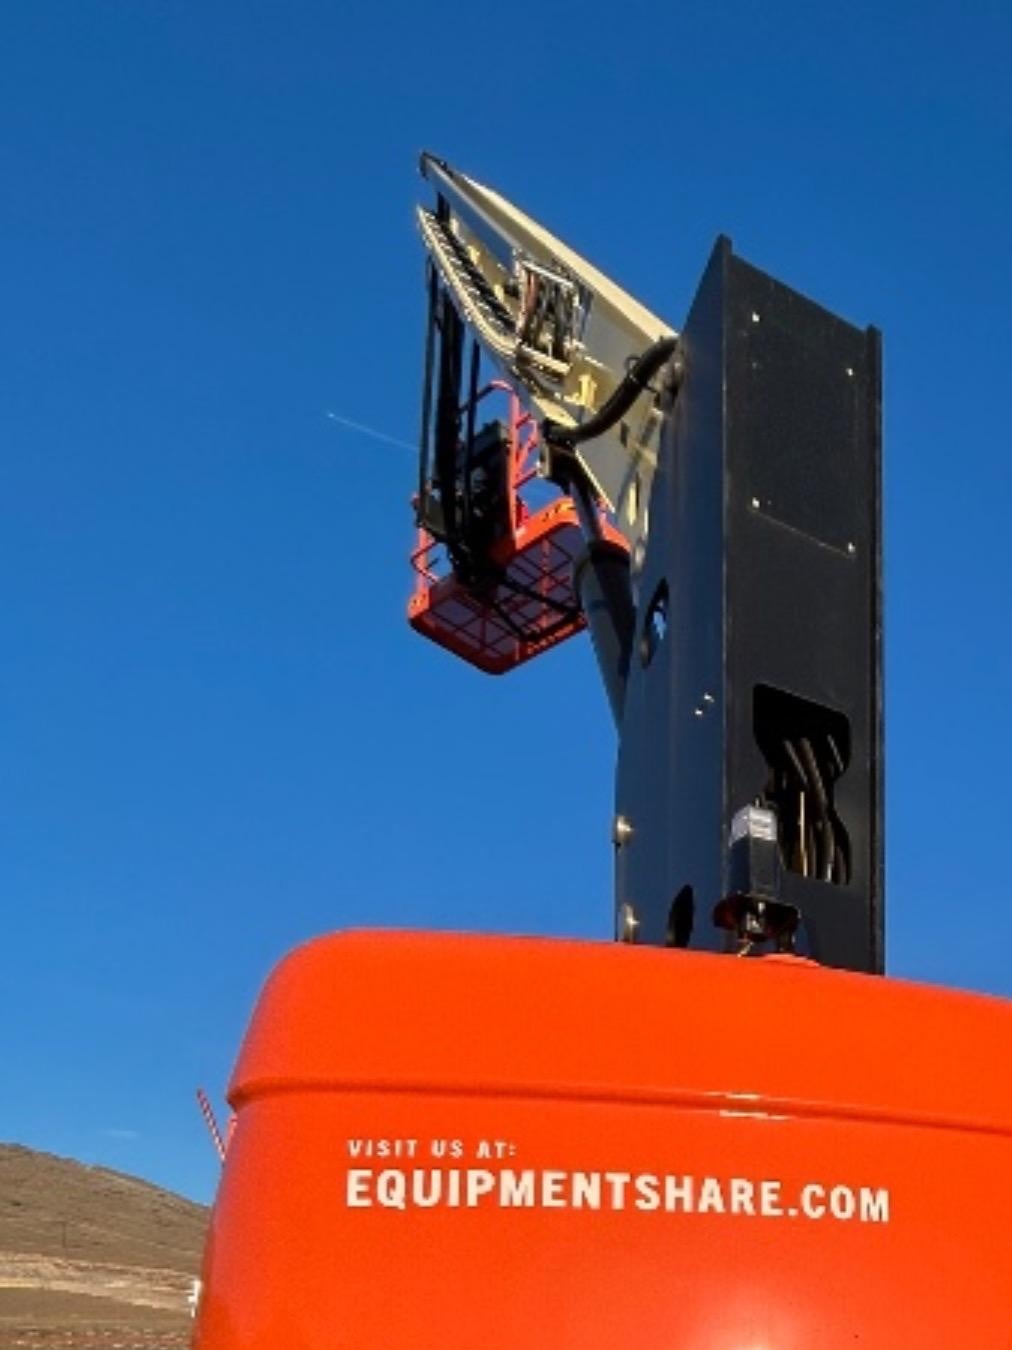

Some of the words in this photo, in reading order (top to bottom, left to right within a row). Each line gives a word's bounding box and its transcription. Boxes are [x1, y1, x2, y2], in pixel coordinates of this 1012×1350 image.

[348, 1139, 418, 1158] VISIT
[431, 1140, 463, 1158] US
[476, 1141, 517, 1159] AT:
[346, 1168, 890, 1222] EQUIPMENTSHARE.COM
